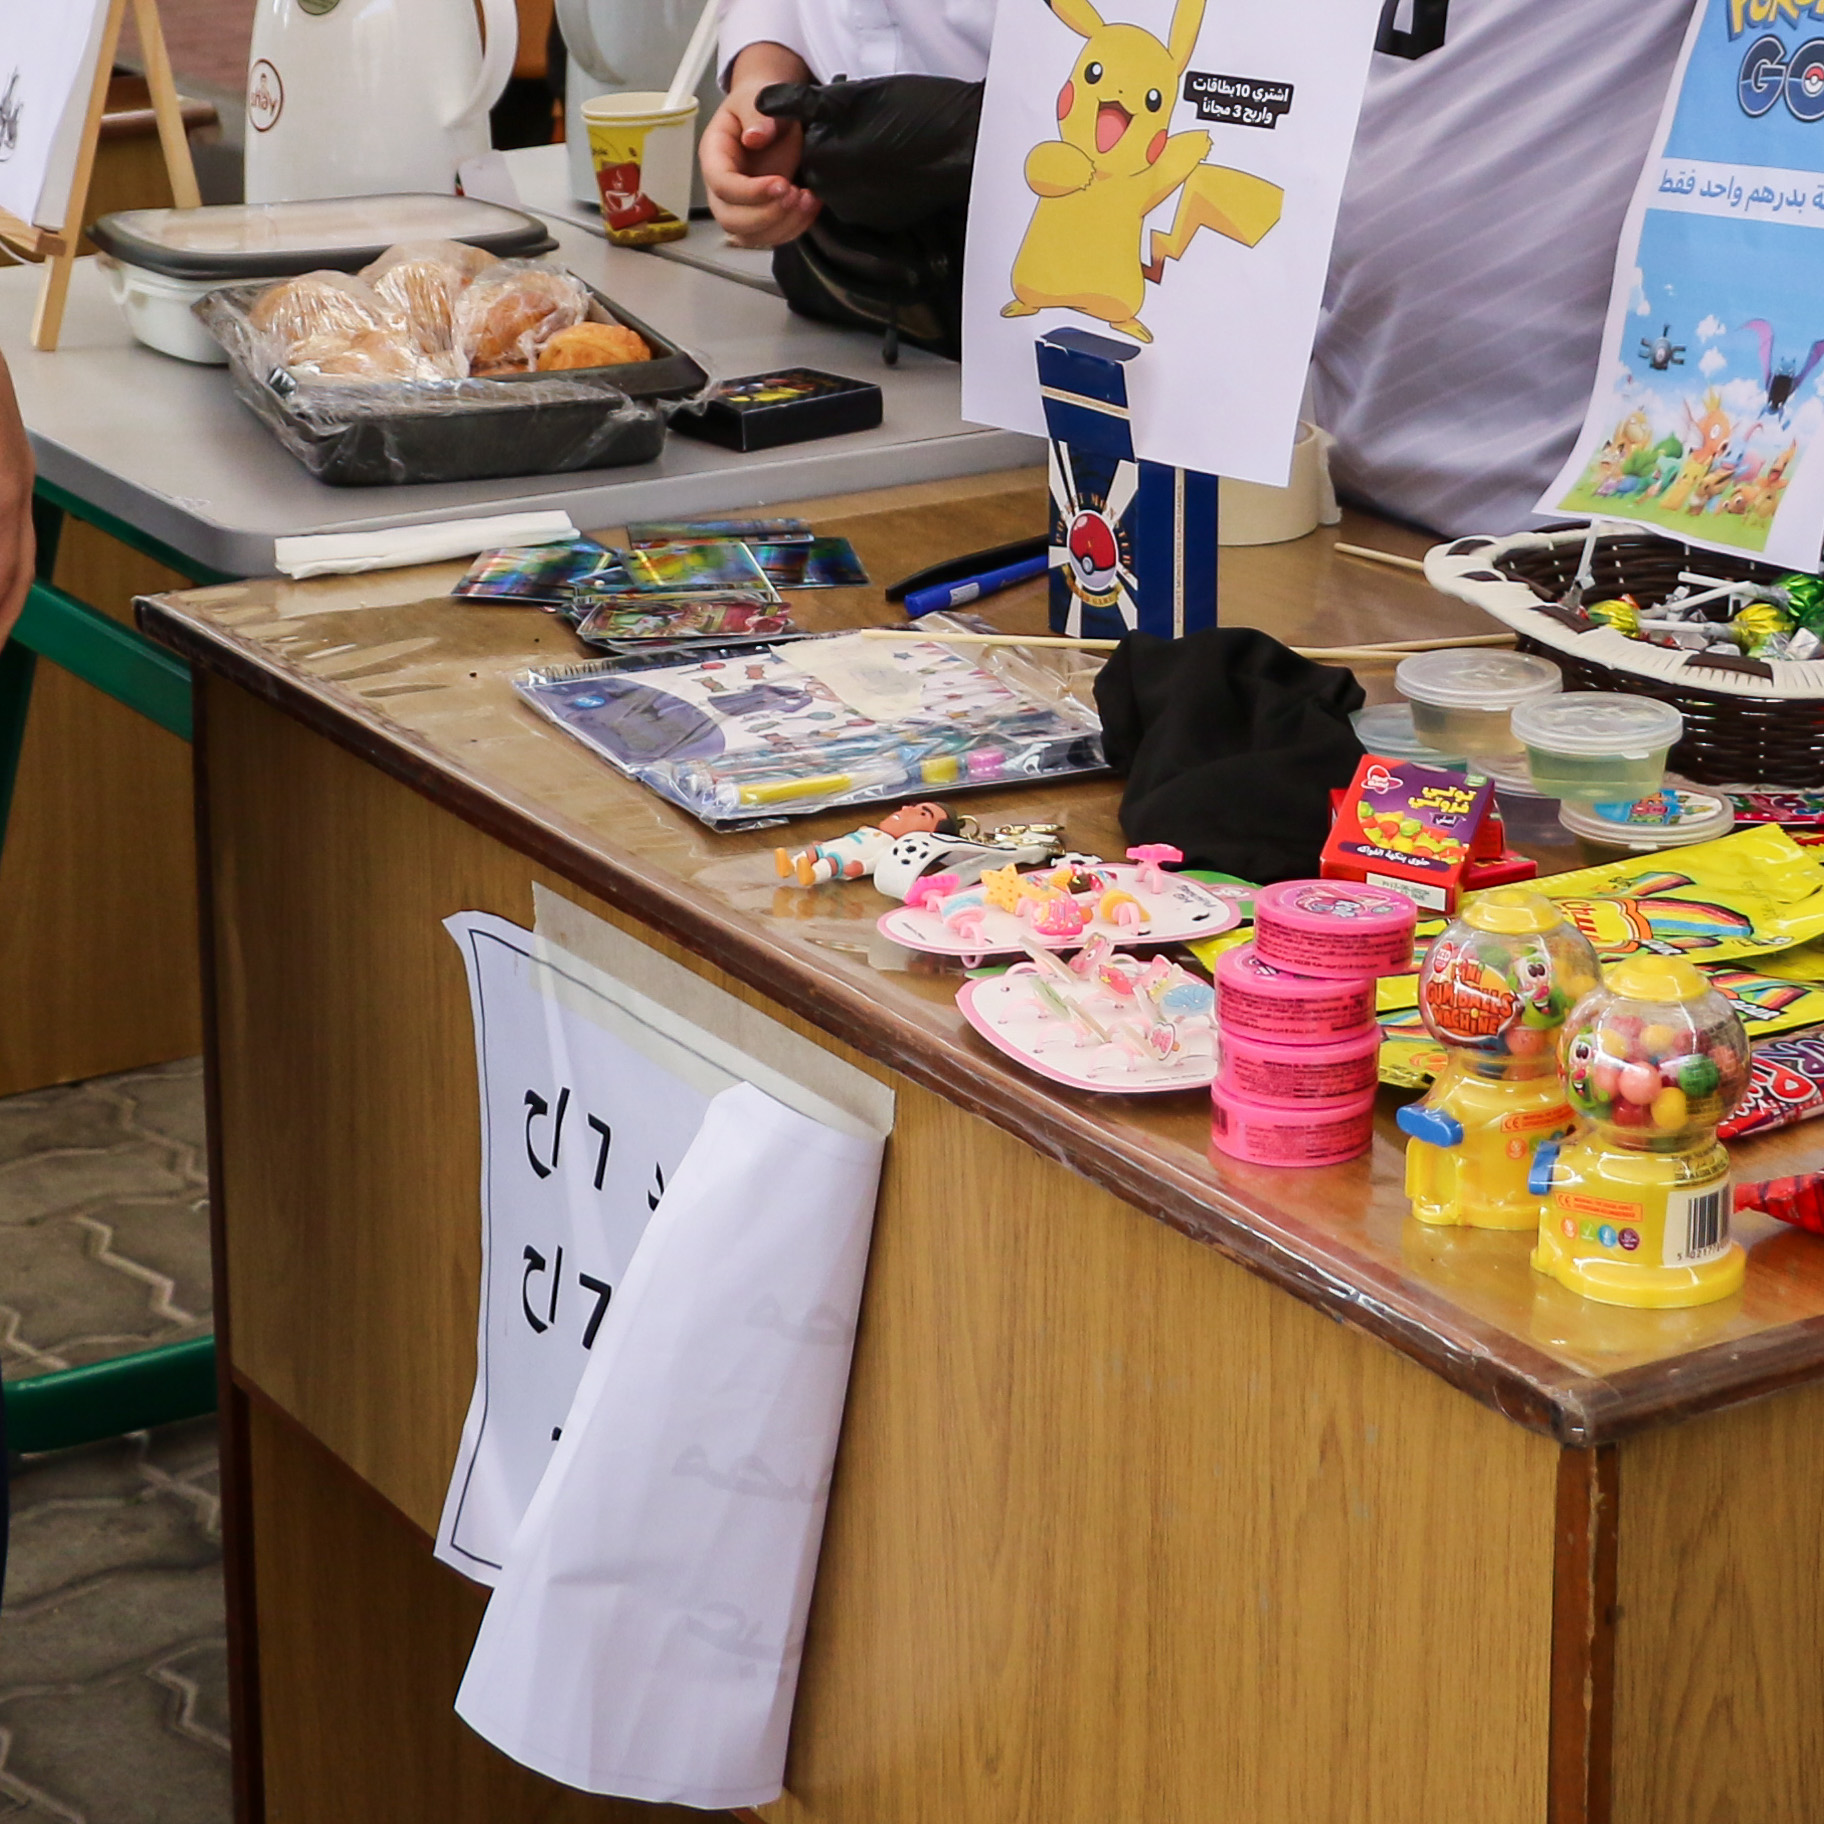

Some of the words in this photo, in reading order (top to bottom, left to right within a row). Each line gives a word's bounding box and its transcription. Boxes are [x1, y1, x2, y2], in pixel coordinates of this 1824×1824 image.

[1251, 87, 1289, 103] اشتري
[1232, 104, 1242, 118] 3
[1242, 106, 1273, 124] واربح
[1658, 169, 1697, 195] فقط
[1699, 175, 1743, 207] واحد
[1744, 185, 1807, 214] بدرهم
